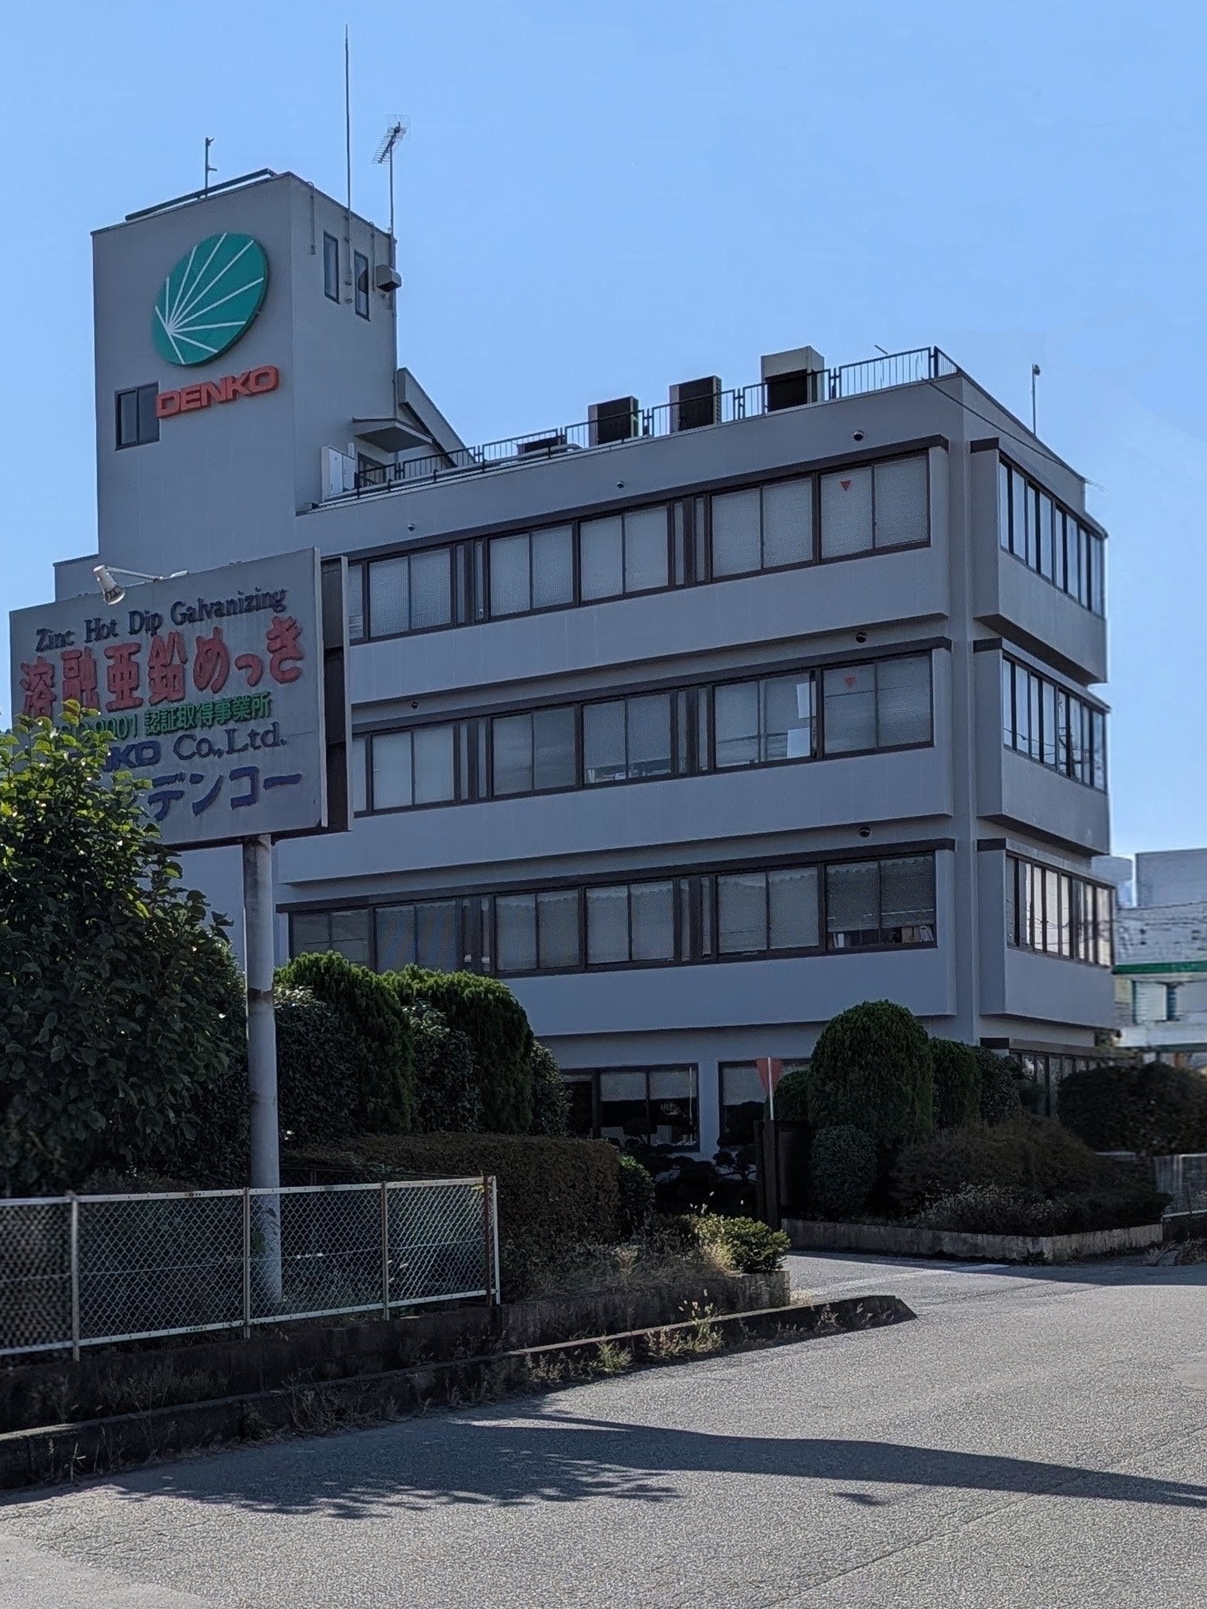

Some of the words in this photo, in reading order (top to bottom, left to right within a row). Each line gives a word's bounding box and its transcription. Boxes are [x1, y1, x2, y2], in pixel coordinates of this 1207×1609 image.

[156, 365, 279, 418] DENKO
[35, 627, 75, 653] Zinc
[83, 617, 119, 643] Hot
[128, 608, 164, 638] Dip
[170, 586, 287, 626] Galvanizing
[144, 691, 272, 736] 認証取得事業所
[147, 765, 302, 822] デンコー
